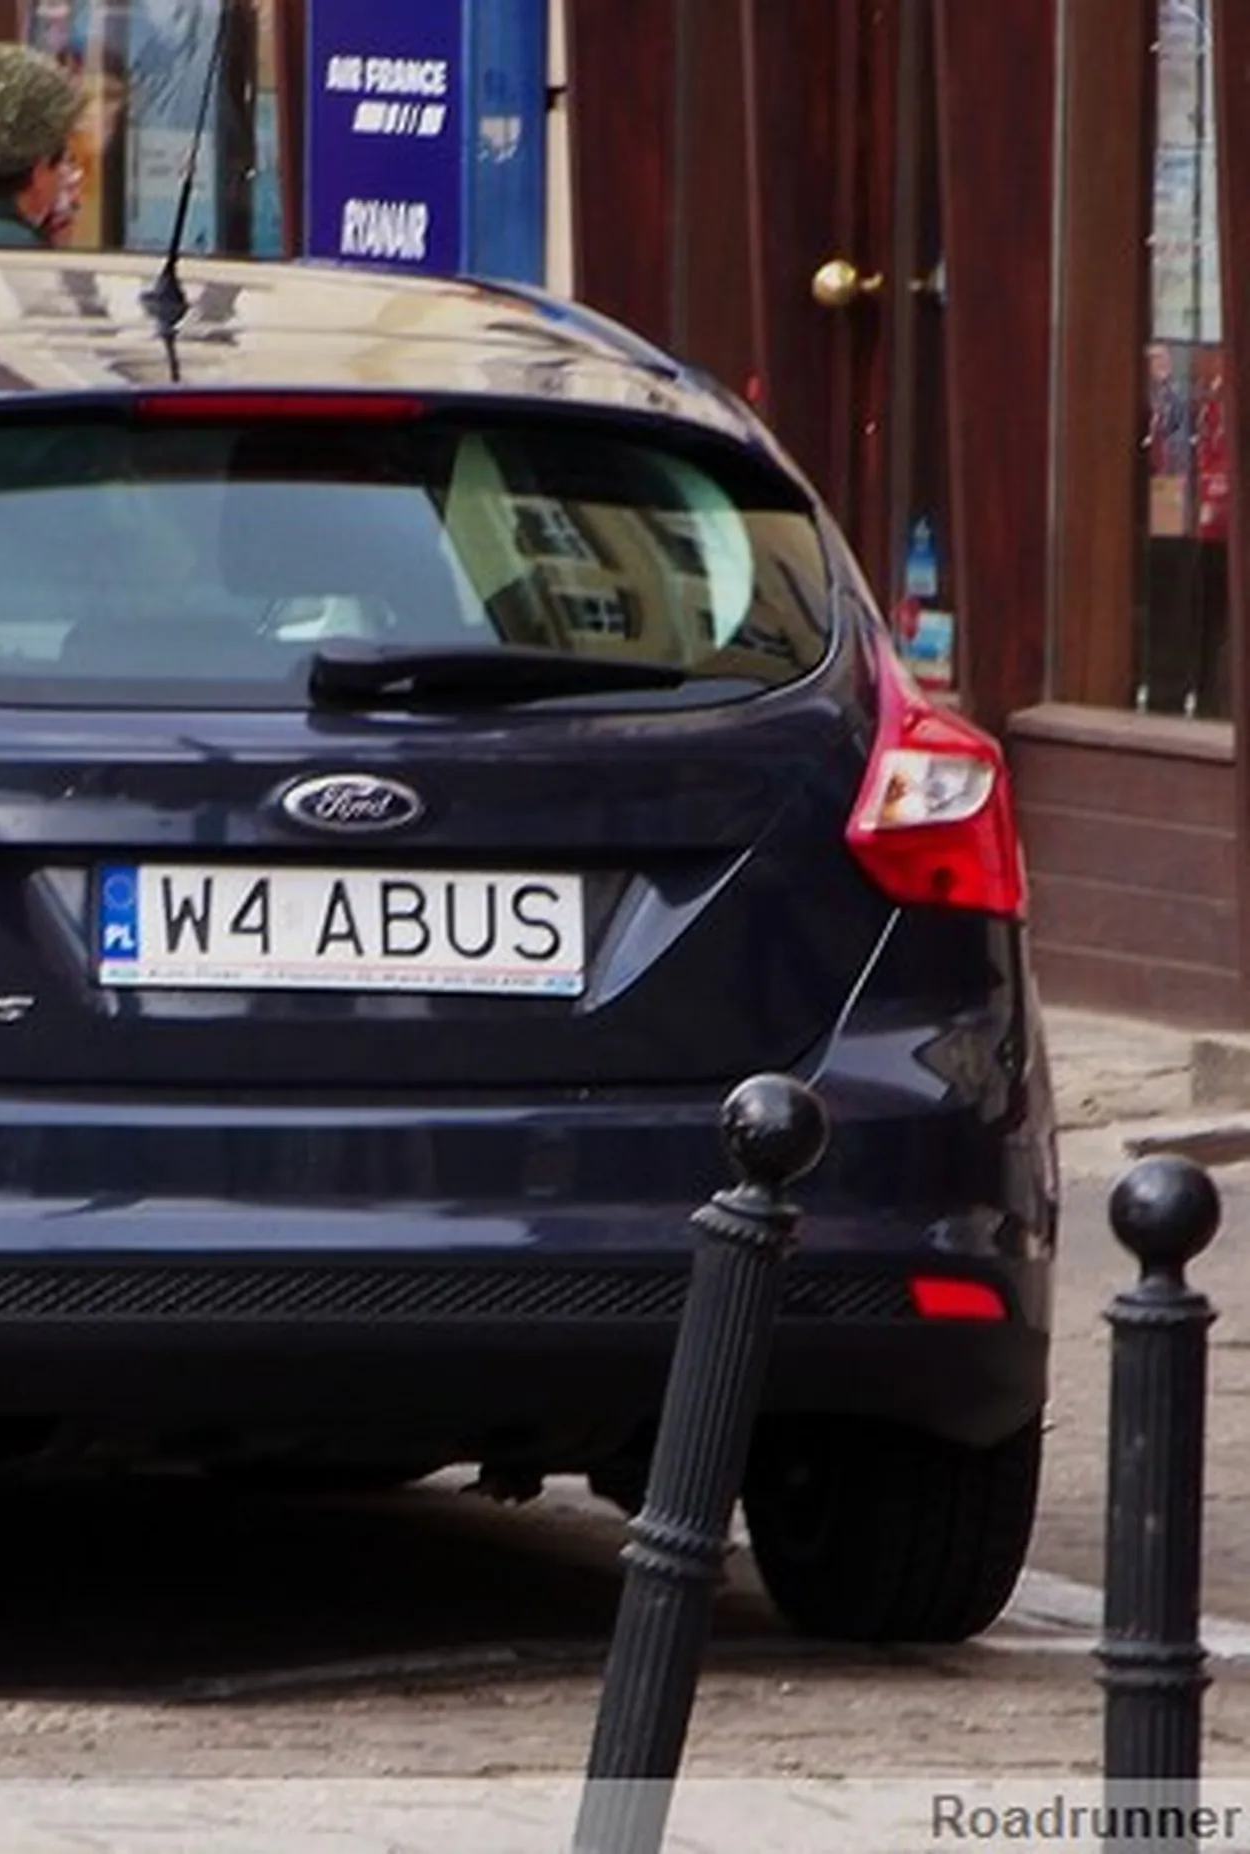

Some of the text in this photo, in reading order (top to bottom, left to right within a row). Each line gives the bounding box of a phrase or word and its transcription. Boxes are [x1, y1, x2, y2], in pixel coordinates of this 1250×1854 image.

[325, 54, 448, 97] AIR FRANCE
[340, 198, 428, 261] RYANAIR
[316, 784, 393, 821] Ford
[104, 923, 135, 951] PL
[162, 875, 562, 961] W4 ABUS
